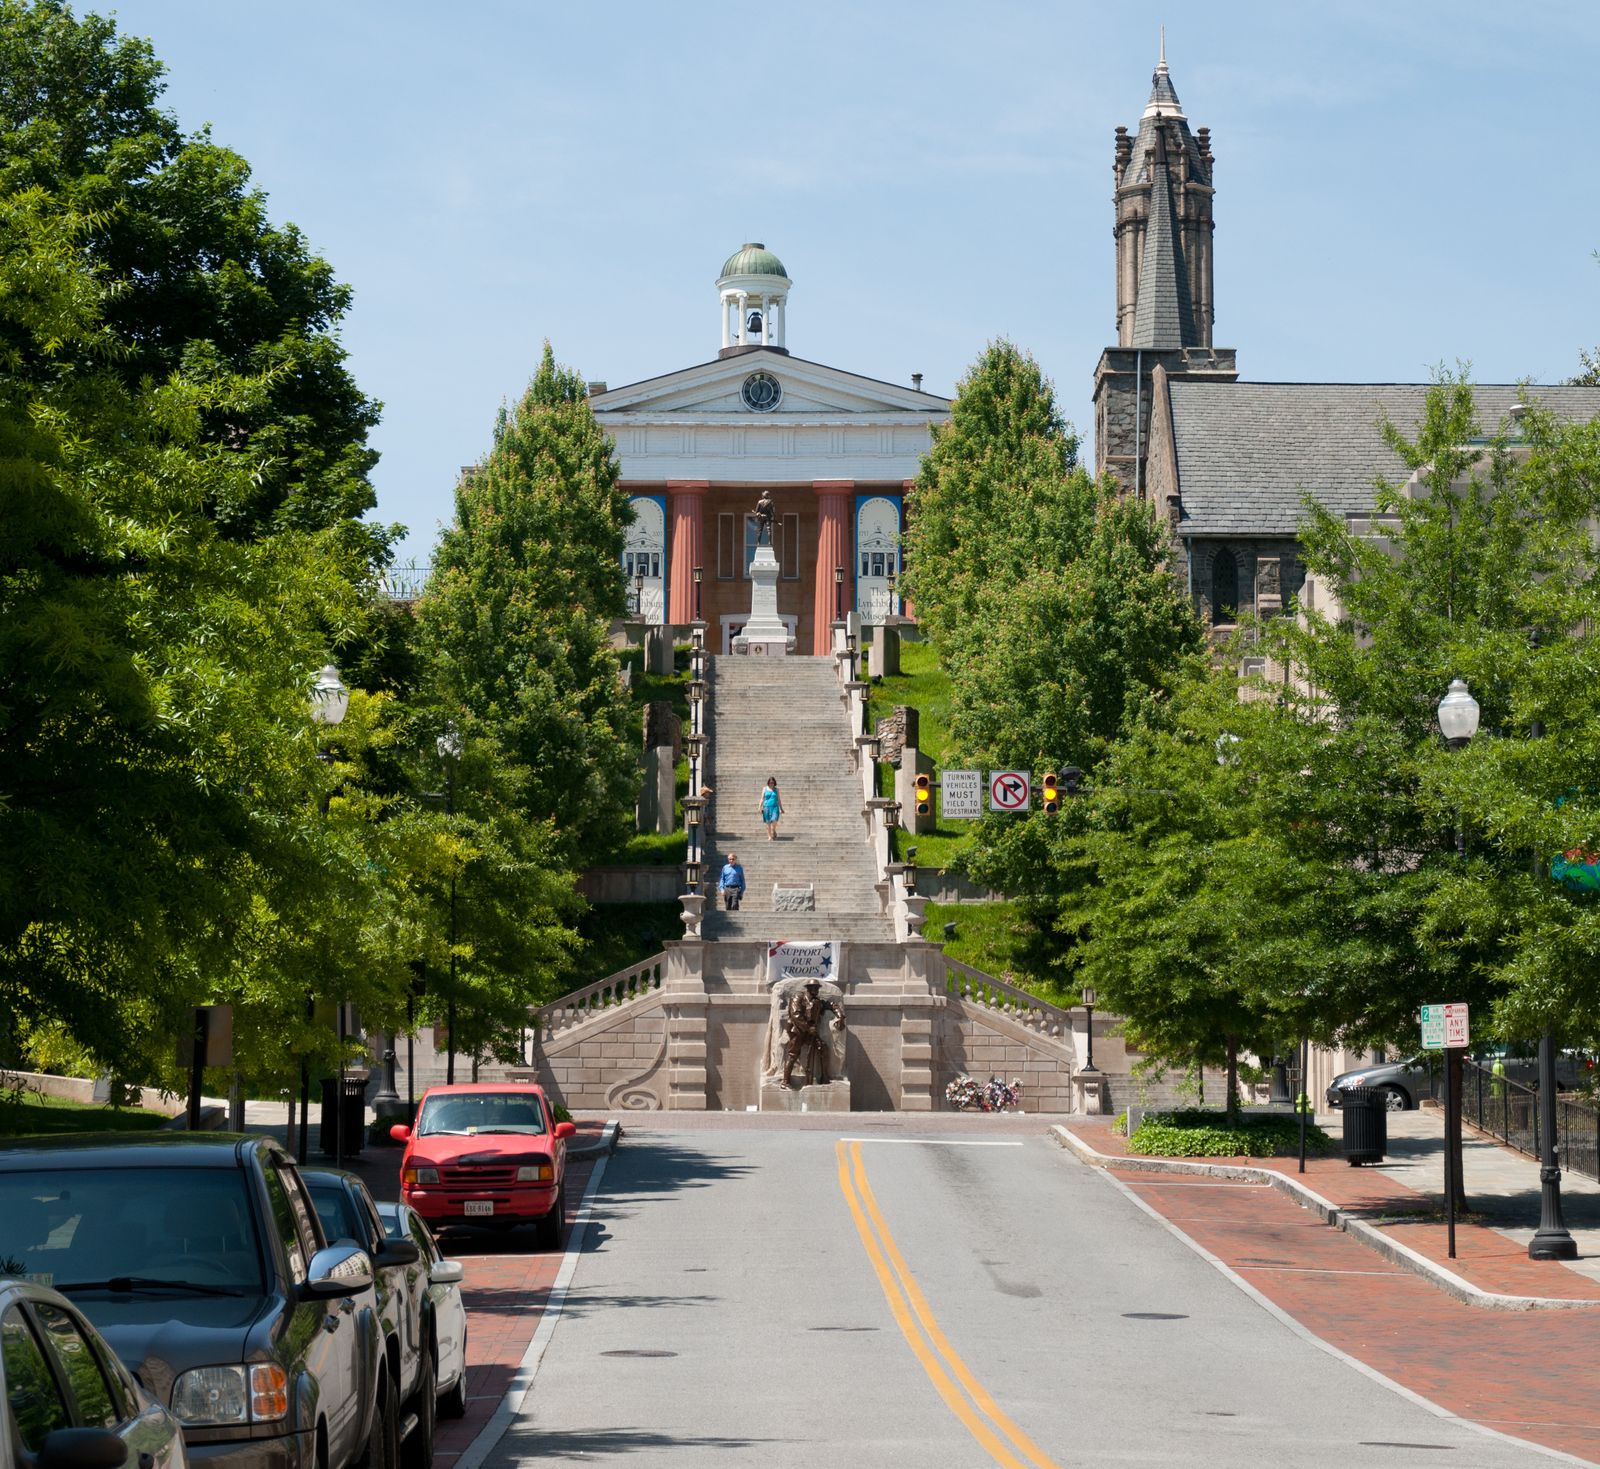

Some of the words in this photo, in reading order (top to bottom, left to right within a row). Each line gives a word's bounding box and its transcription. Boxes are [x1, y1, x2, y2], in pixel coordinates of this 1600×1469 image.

[869, 586, 885, 597] The
[947, 773, 976, 781] TURNING
[945, 781, 978, 789] VEHICLES
[949, 790, 974, 799] MUST
[945, 800, 965, 808] YIELD
[780, 947, 822, 957] SUPPORT
[791, 957, 812, 966] OUR
[783, 966, 820, 975] TROOPS
[1450, 1019, 1463, 1027] ANY
[1449, 1028, 1464, 1036] TIME
